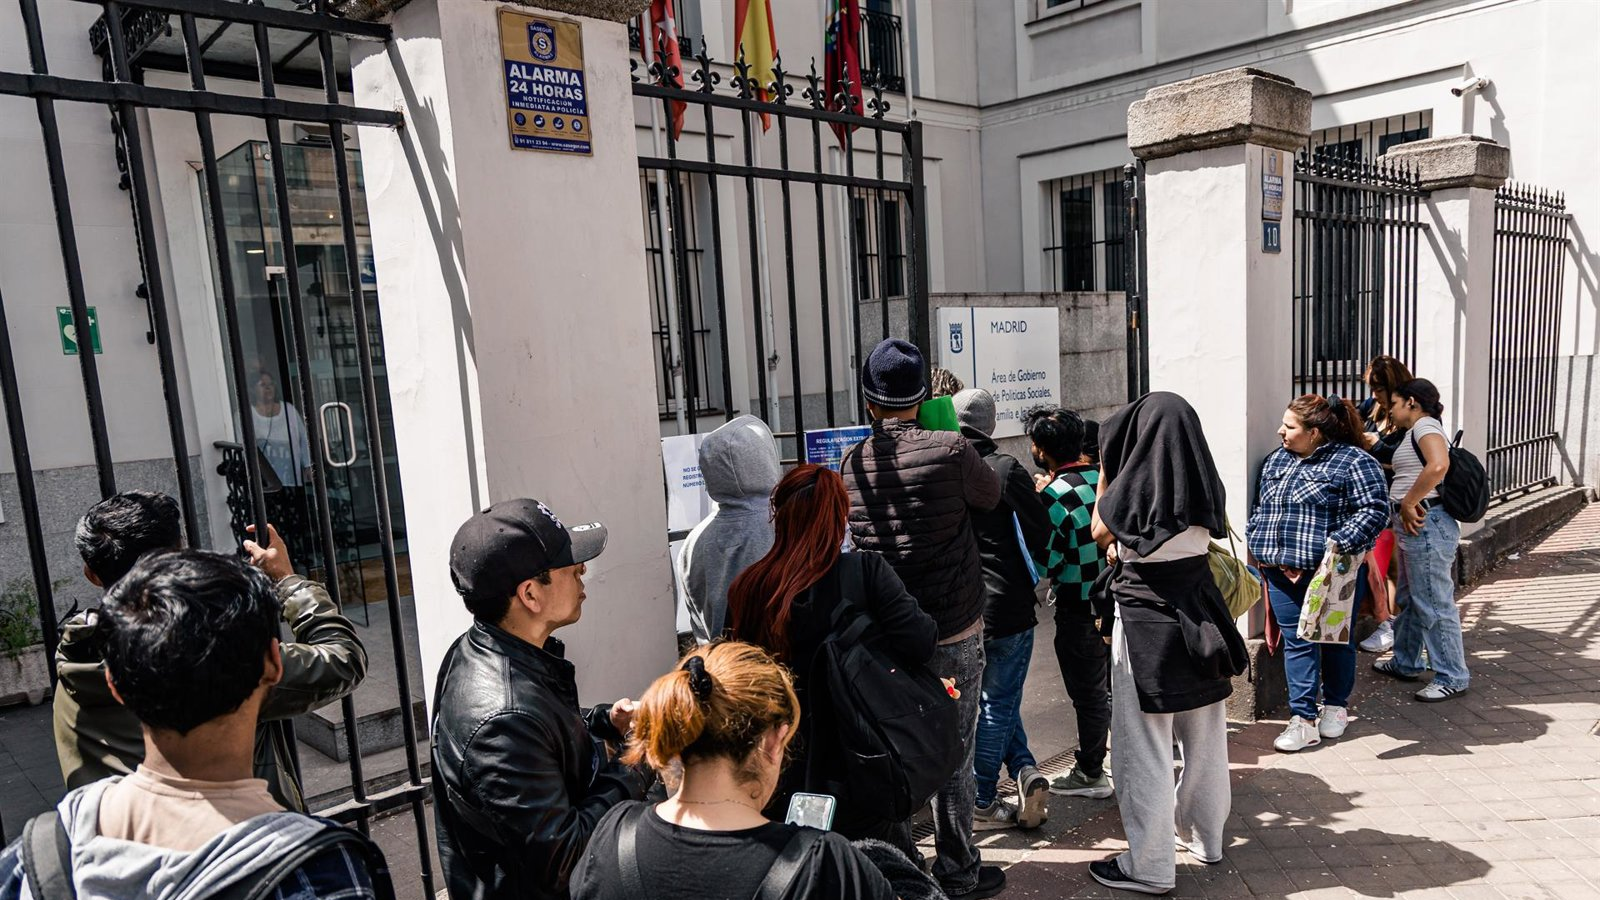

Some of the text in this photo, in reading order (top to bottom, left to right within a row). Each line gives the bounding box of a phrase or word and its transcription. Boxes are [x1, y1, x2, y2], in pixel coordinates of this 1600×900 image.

[538, 38, 547, 49] S
[509, 63, 582, 87] ALARMA
[509, 80, 584, 101] 24 HORAS
[511, 101, 551, 111] INMEDIATA
[1267, 227, 1278, 247] 10
[990, 320, 1028, 334] MADRID
[991, 368, 1046, 383] Área de Gobierno
